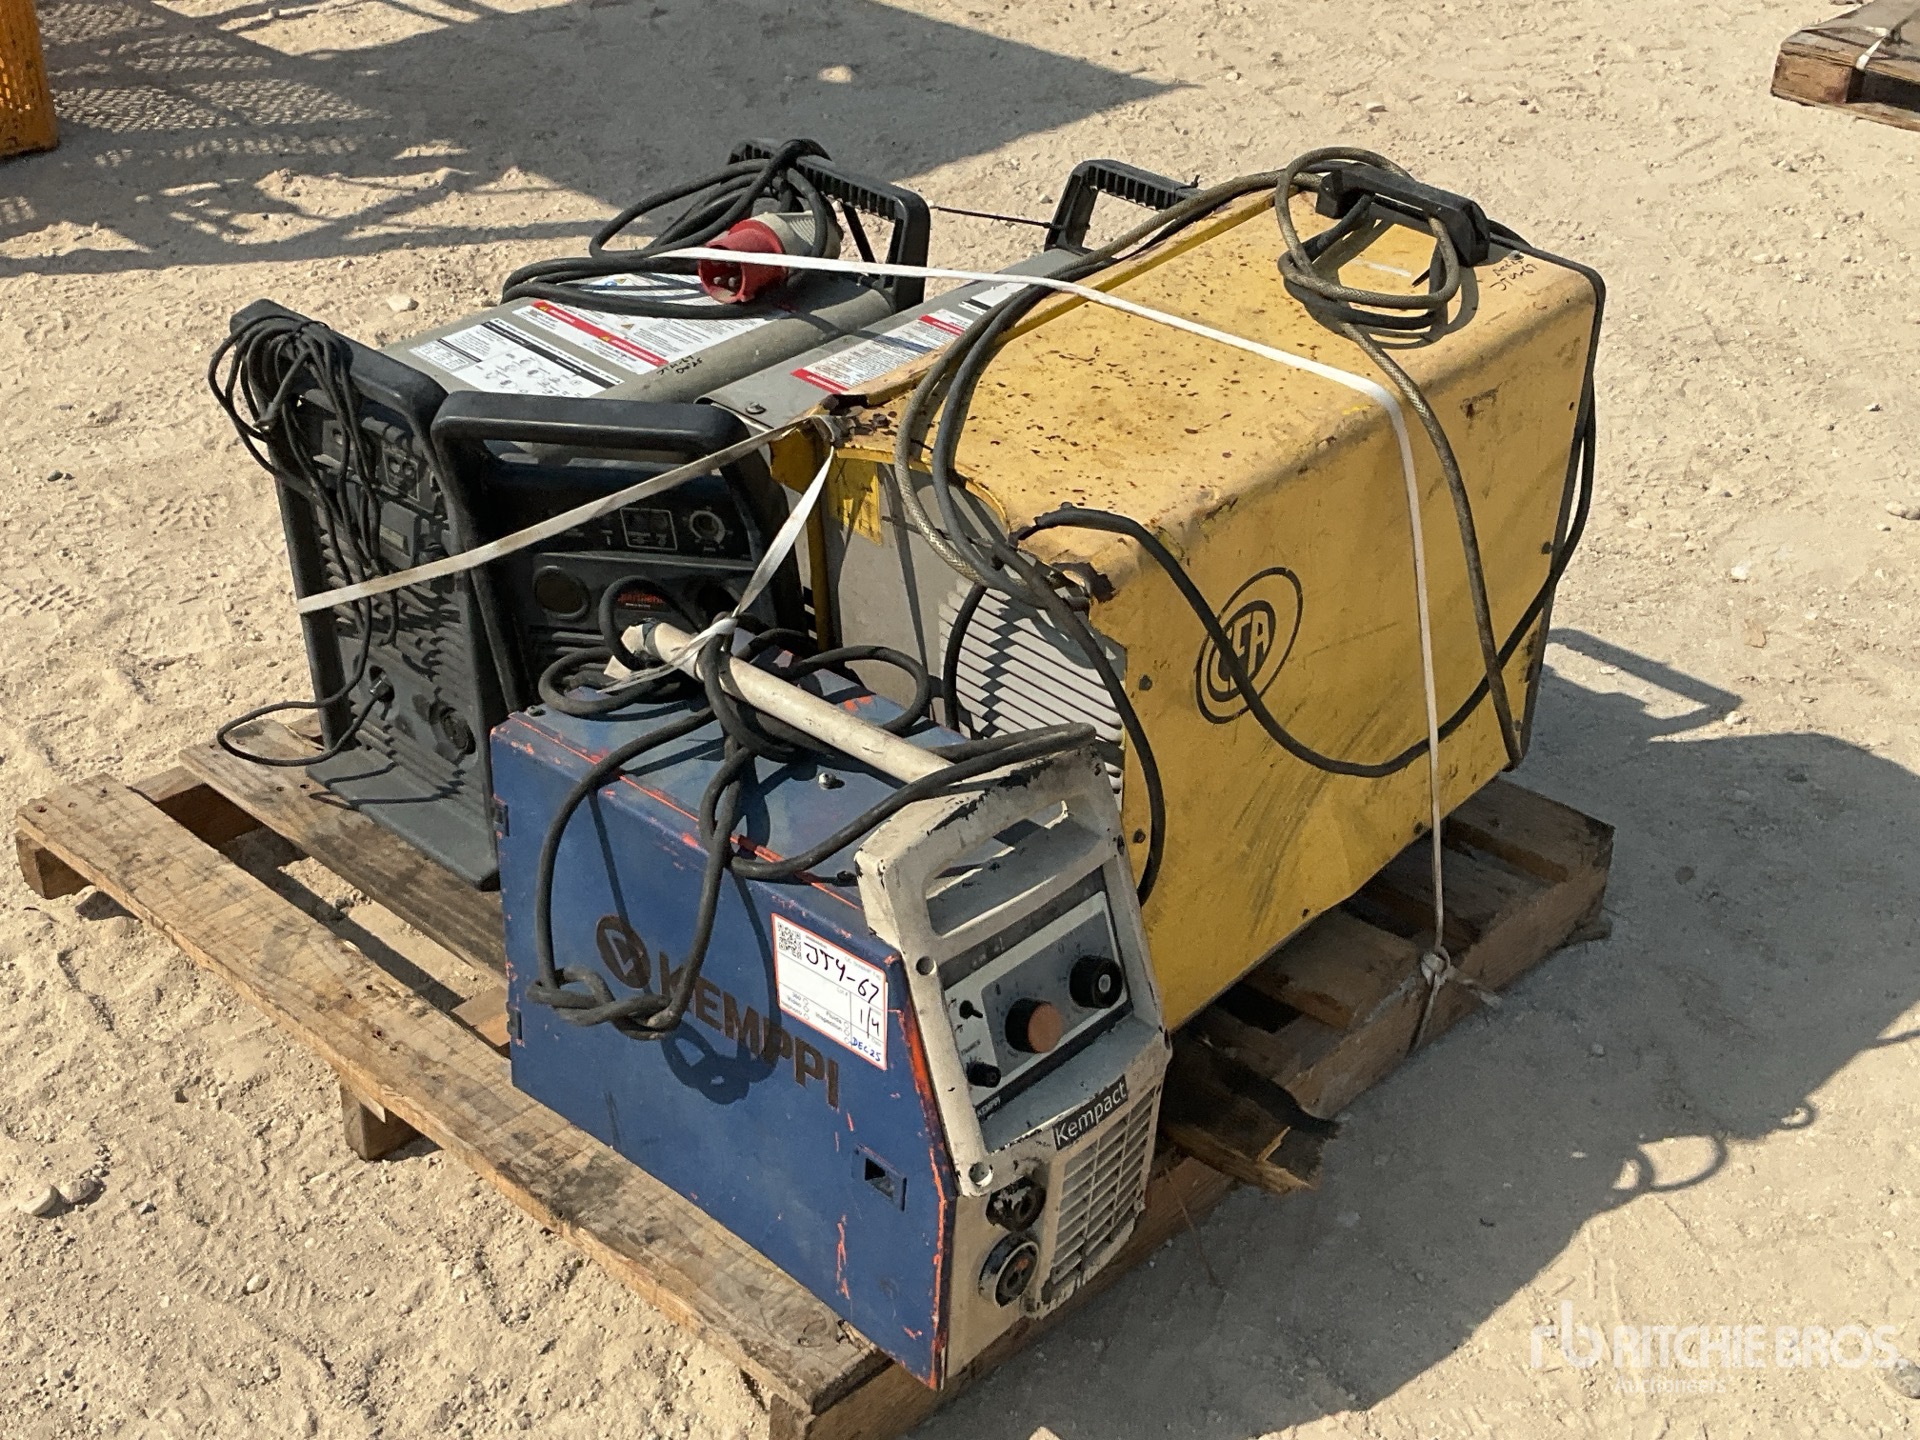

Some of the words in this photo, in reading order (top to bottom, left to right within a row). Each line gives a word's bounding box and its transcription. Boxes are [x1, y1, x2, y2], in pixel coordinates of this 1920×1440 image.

[803, 942, 880, 1004] JT4-67
[860, 1007, 880, 1039] 1/4
[1055, 1081, 1127, 1146] Kempact
